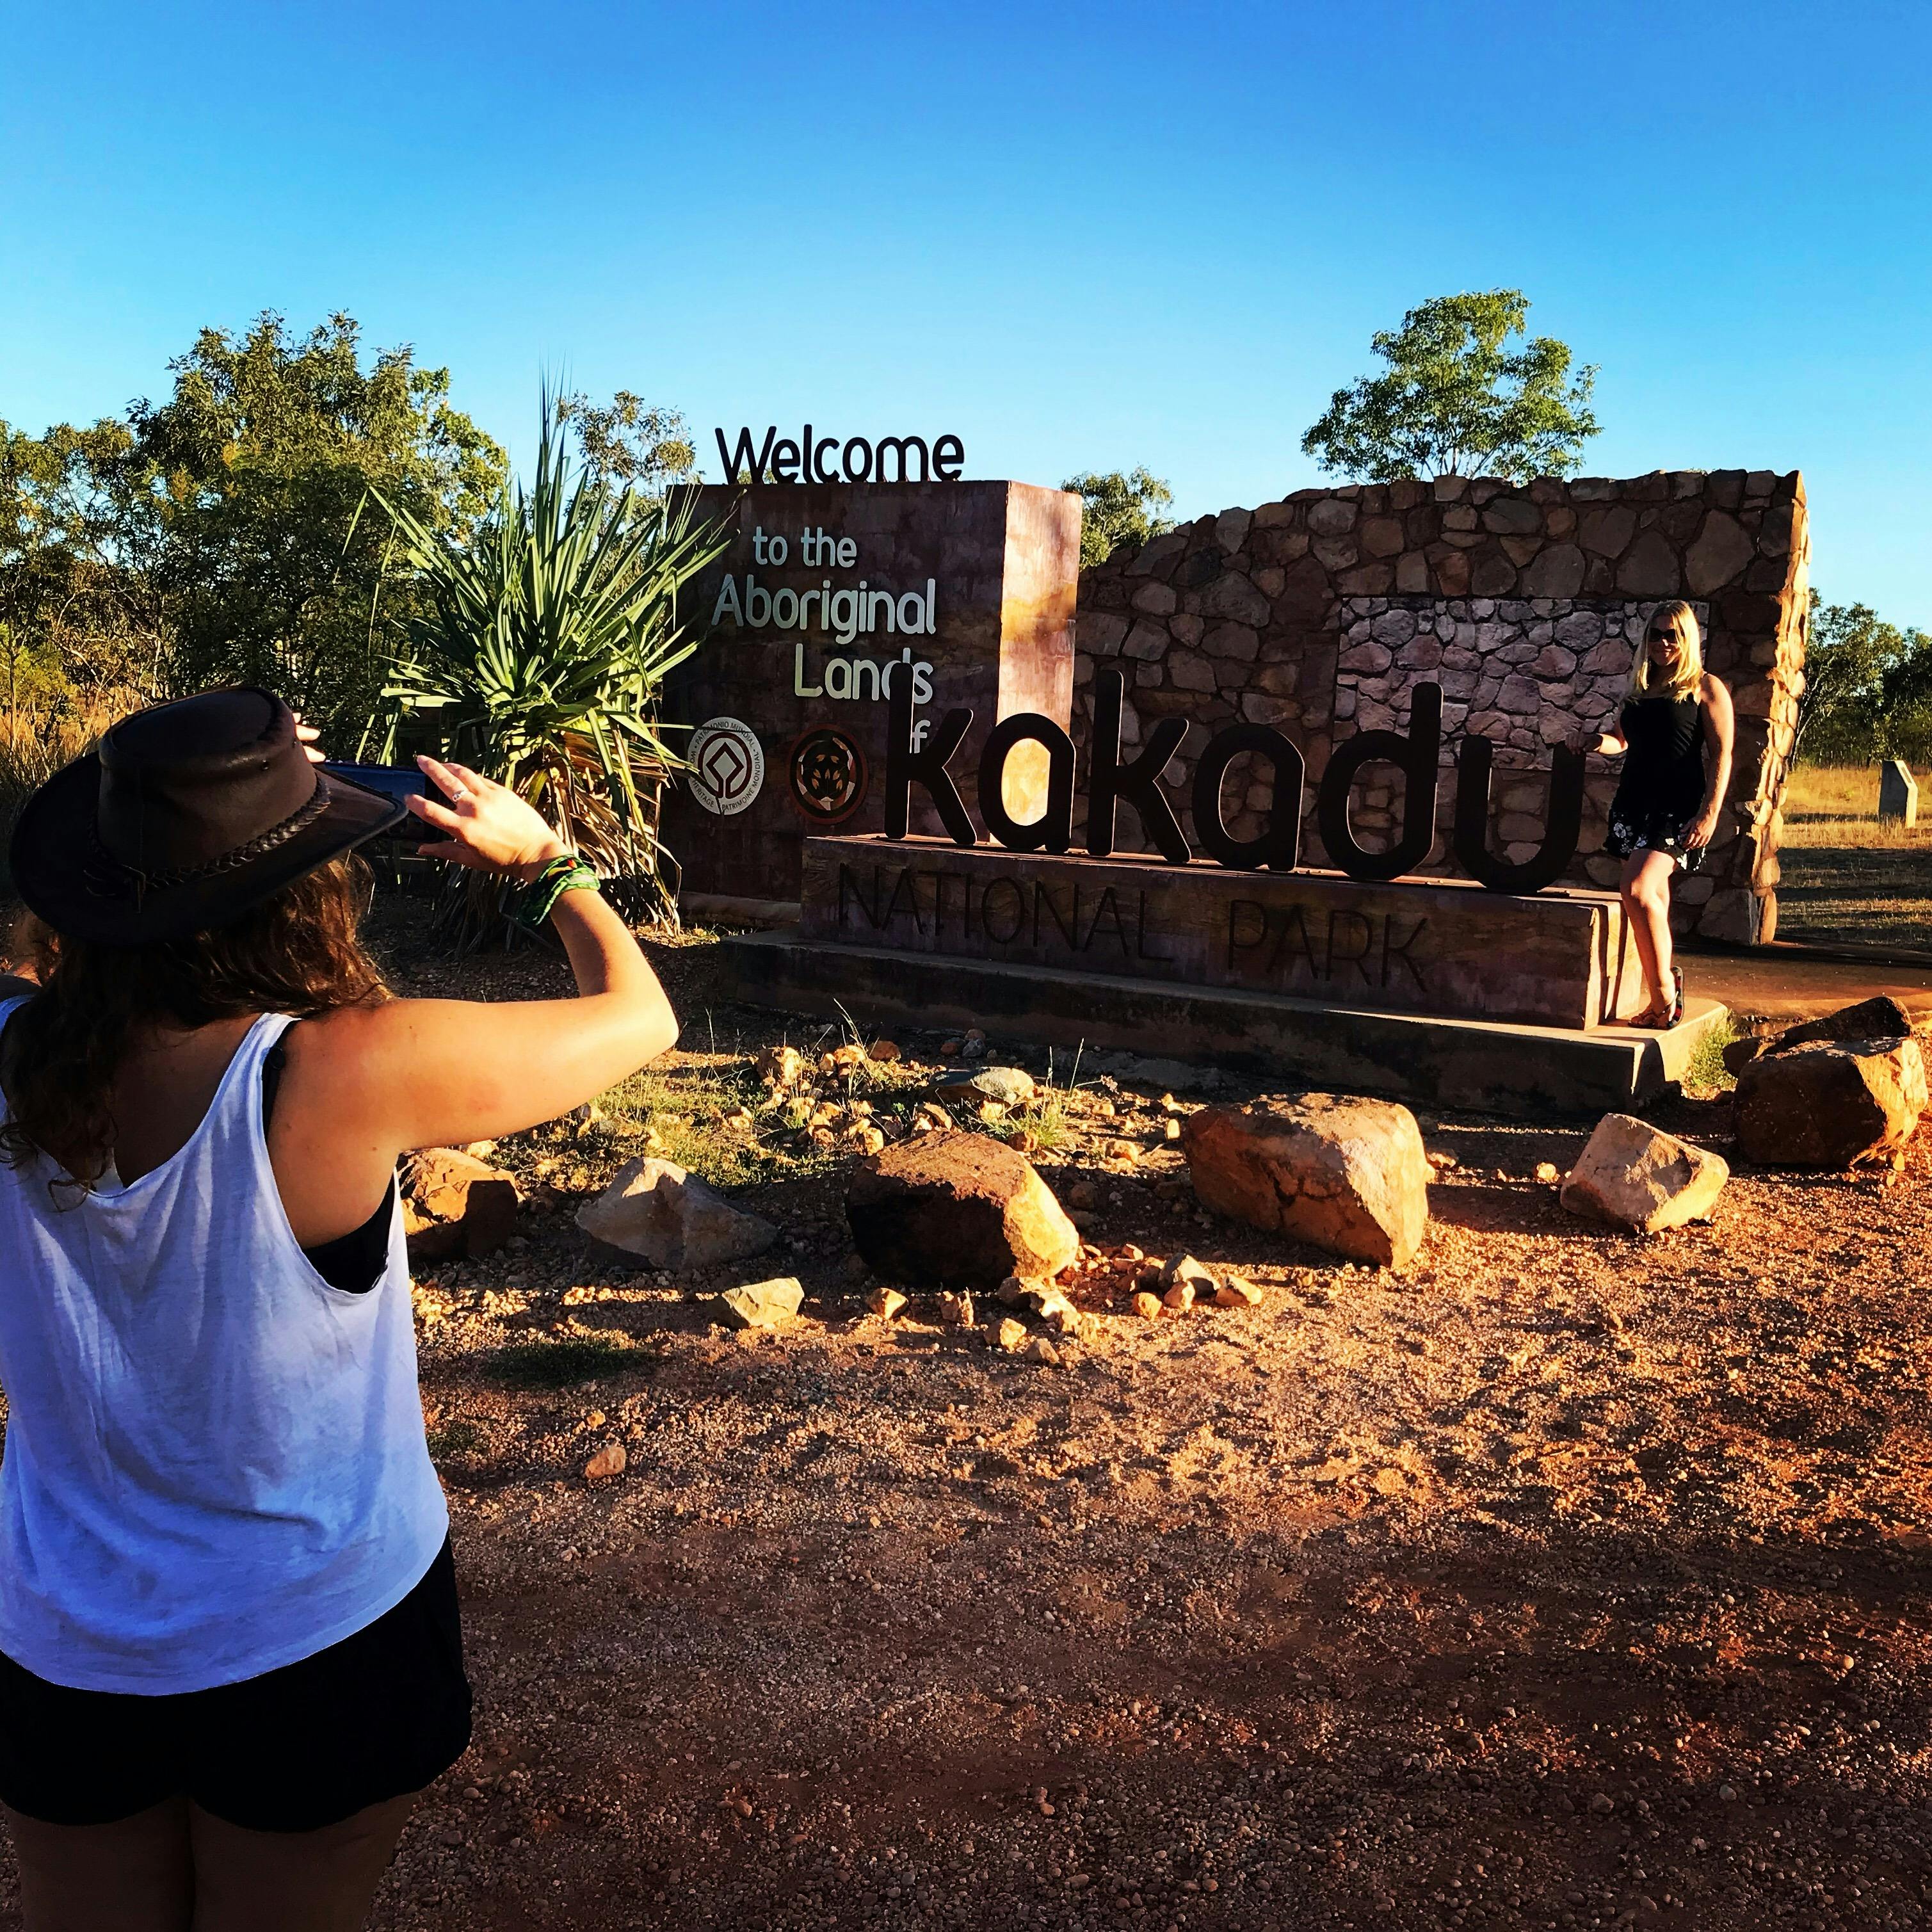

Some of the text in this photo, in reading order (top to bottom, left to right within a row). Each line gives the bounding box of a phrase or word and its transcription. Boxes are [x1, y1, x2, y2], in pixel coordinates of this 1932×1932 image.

[715, 424, 965, 485] Welcome
[753, 526, 857, 568] to the
[711, 573, 936, 645] Aboriginal
[912, 720, 931, 754] f
[721, 752, 761, 811] PATRIMOINE MONDIAL
[884, 661, 1586, 892] kakadu
[838, 862, 1428, 992] NATIONAL PARK
